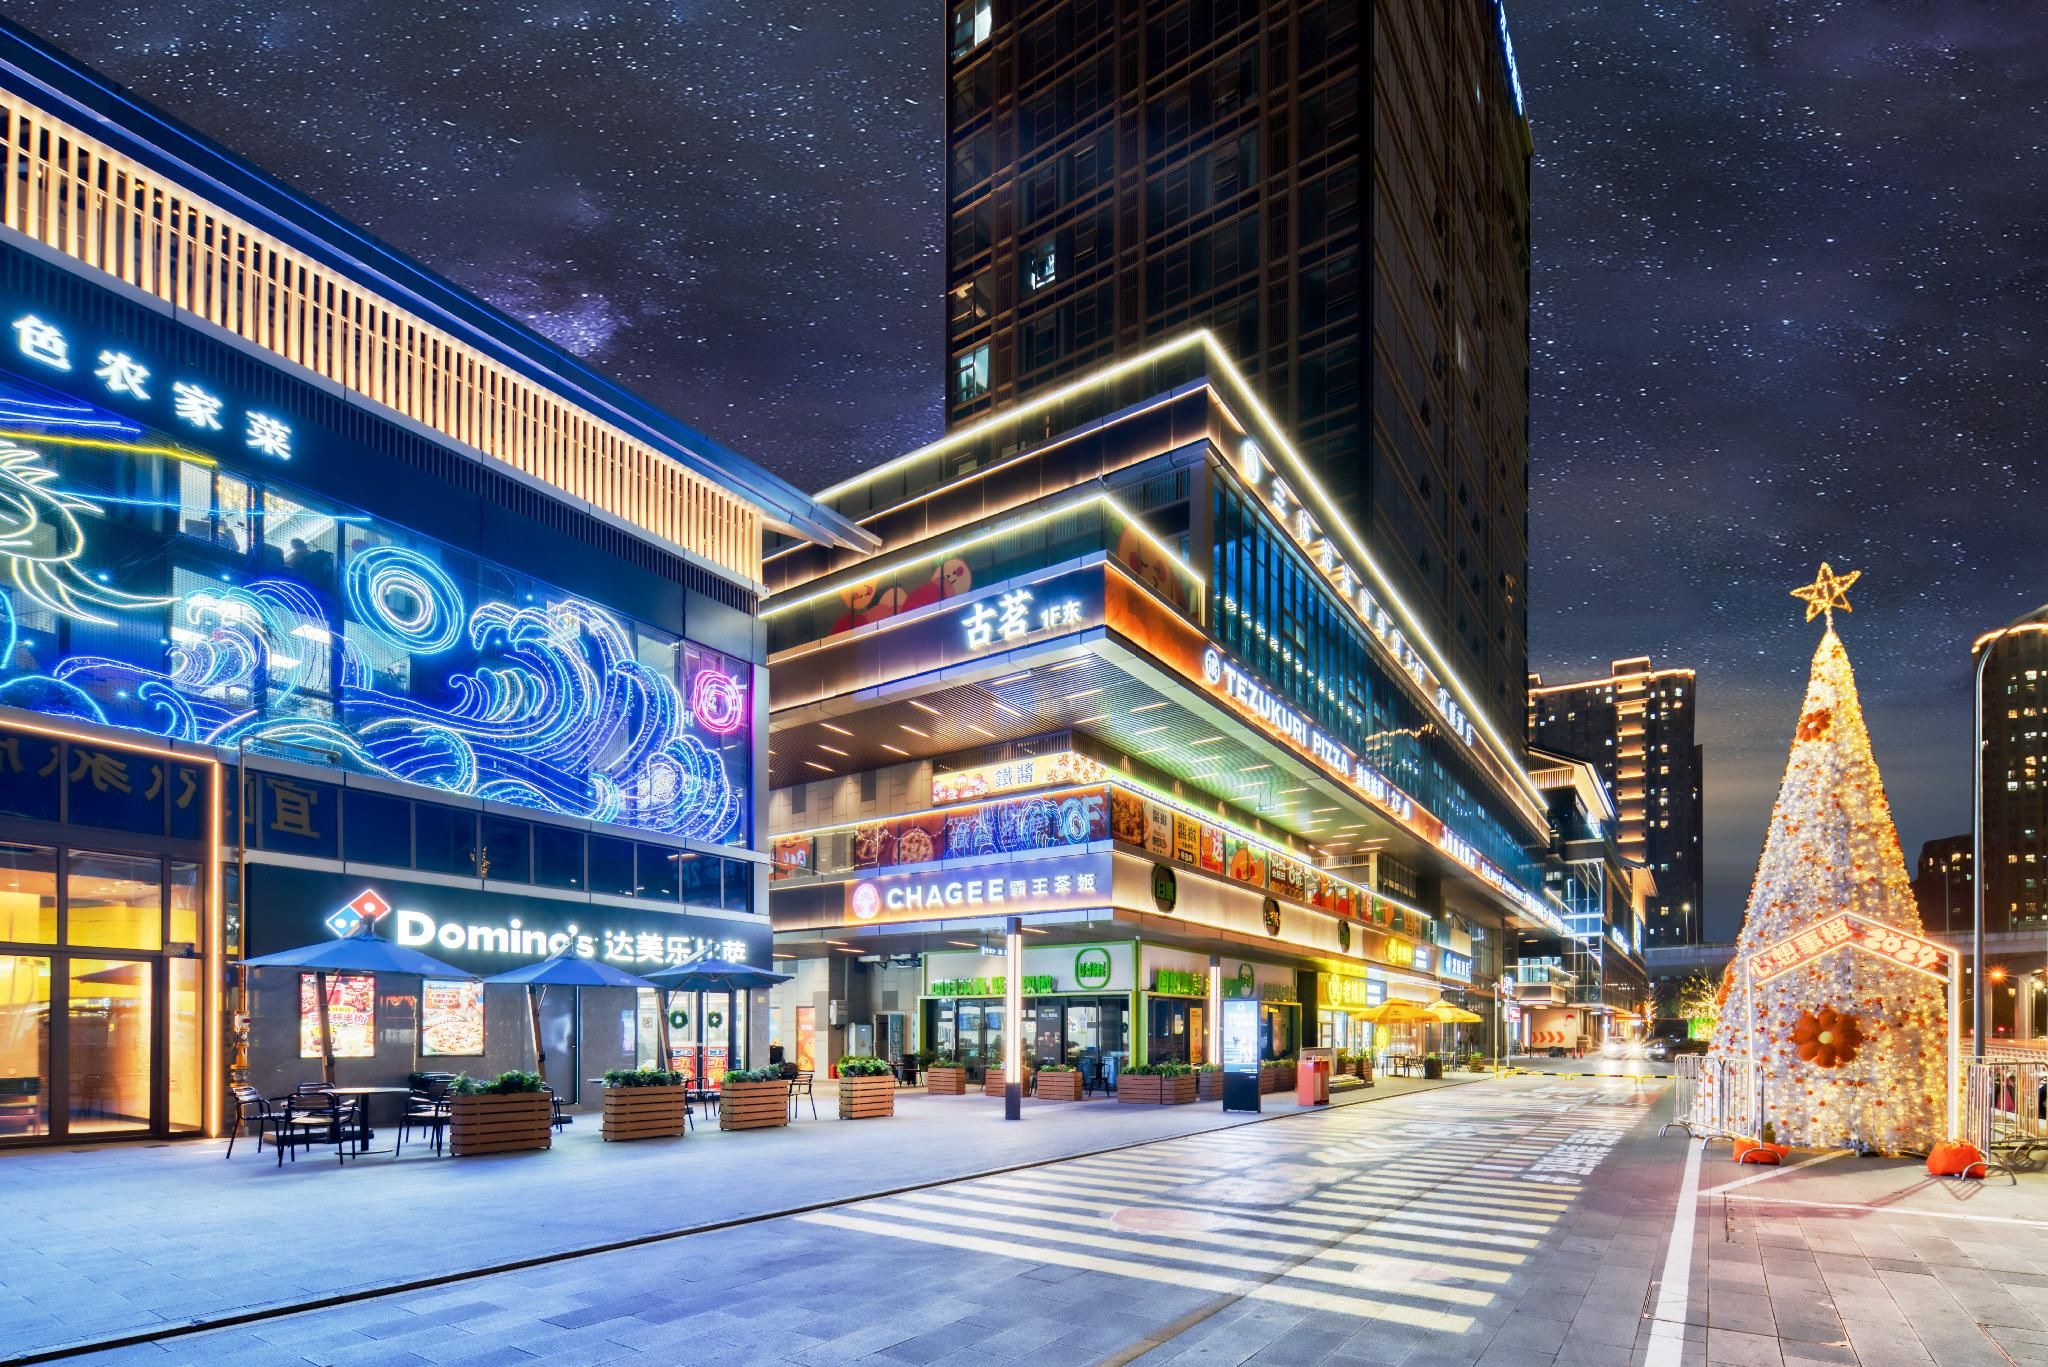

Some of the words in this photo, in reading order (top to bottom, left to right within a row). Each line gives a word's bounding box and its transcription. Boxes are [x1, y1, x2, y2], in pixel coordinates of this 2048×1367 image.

[12, 314, 292, 460] 色农家菜
[962, 588, 1034, 651] 古茗
[1040, 599, 1083, 628] 1F东
[1223, 661, 1307, 747] TEZUKURI
[1312, 730, 1351, 777] PIZZA
[886, 878, 1005, 909] CHAGEE
[1009, 872, 1097, 898] 霸王茶姬
[396, 910, 595, 960] Domino's
[1749, 917, 1853, 978] 心想事橙
[1863, 927, 1940, 969] 2024
